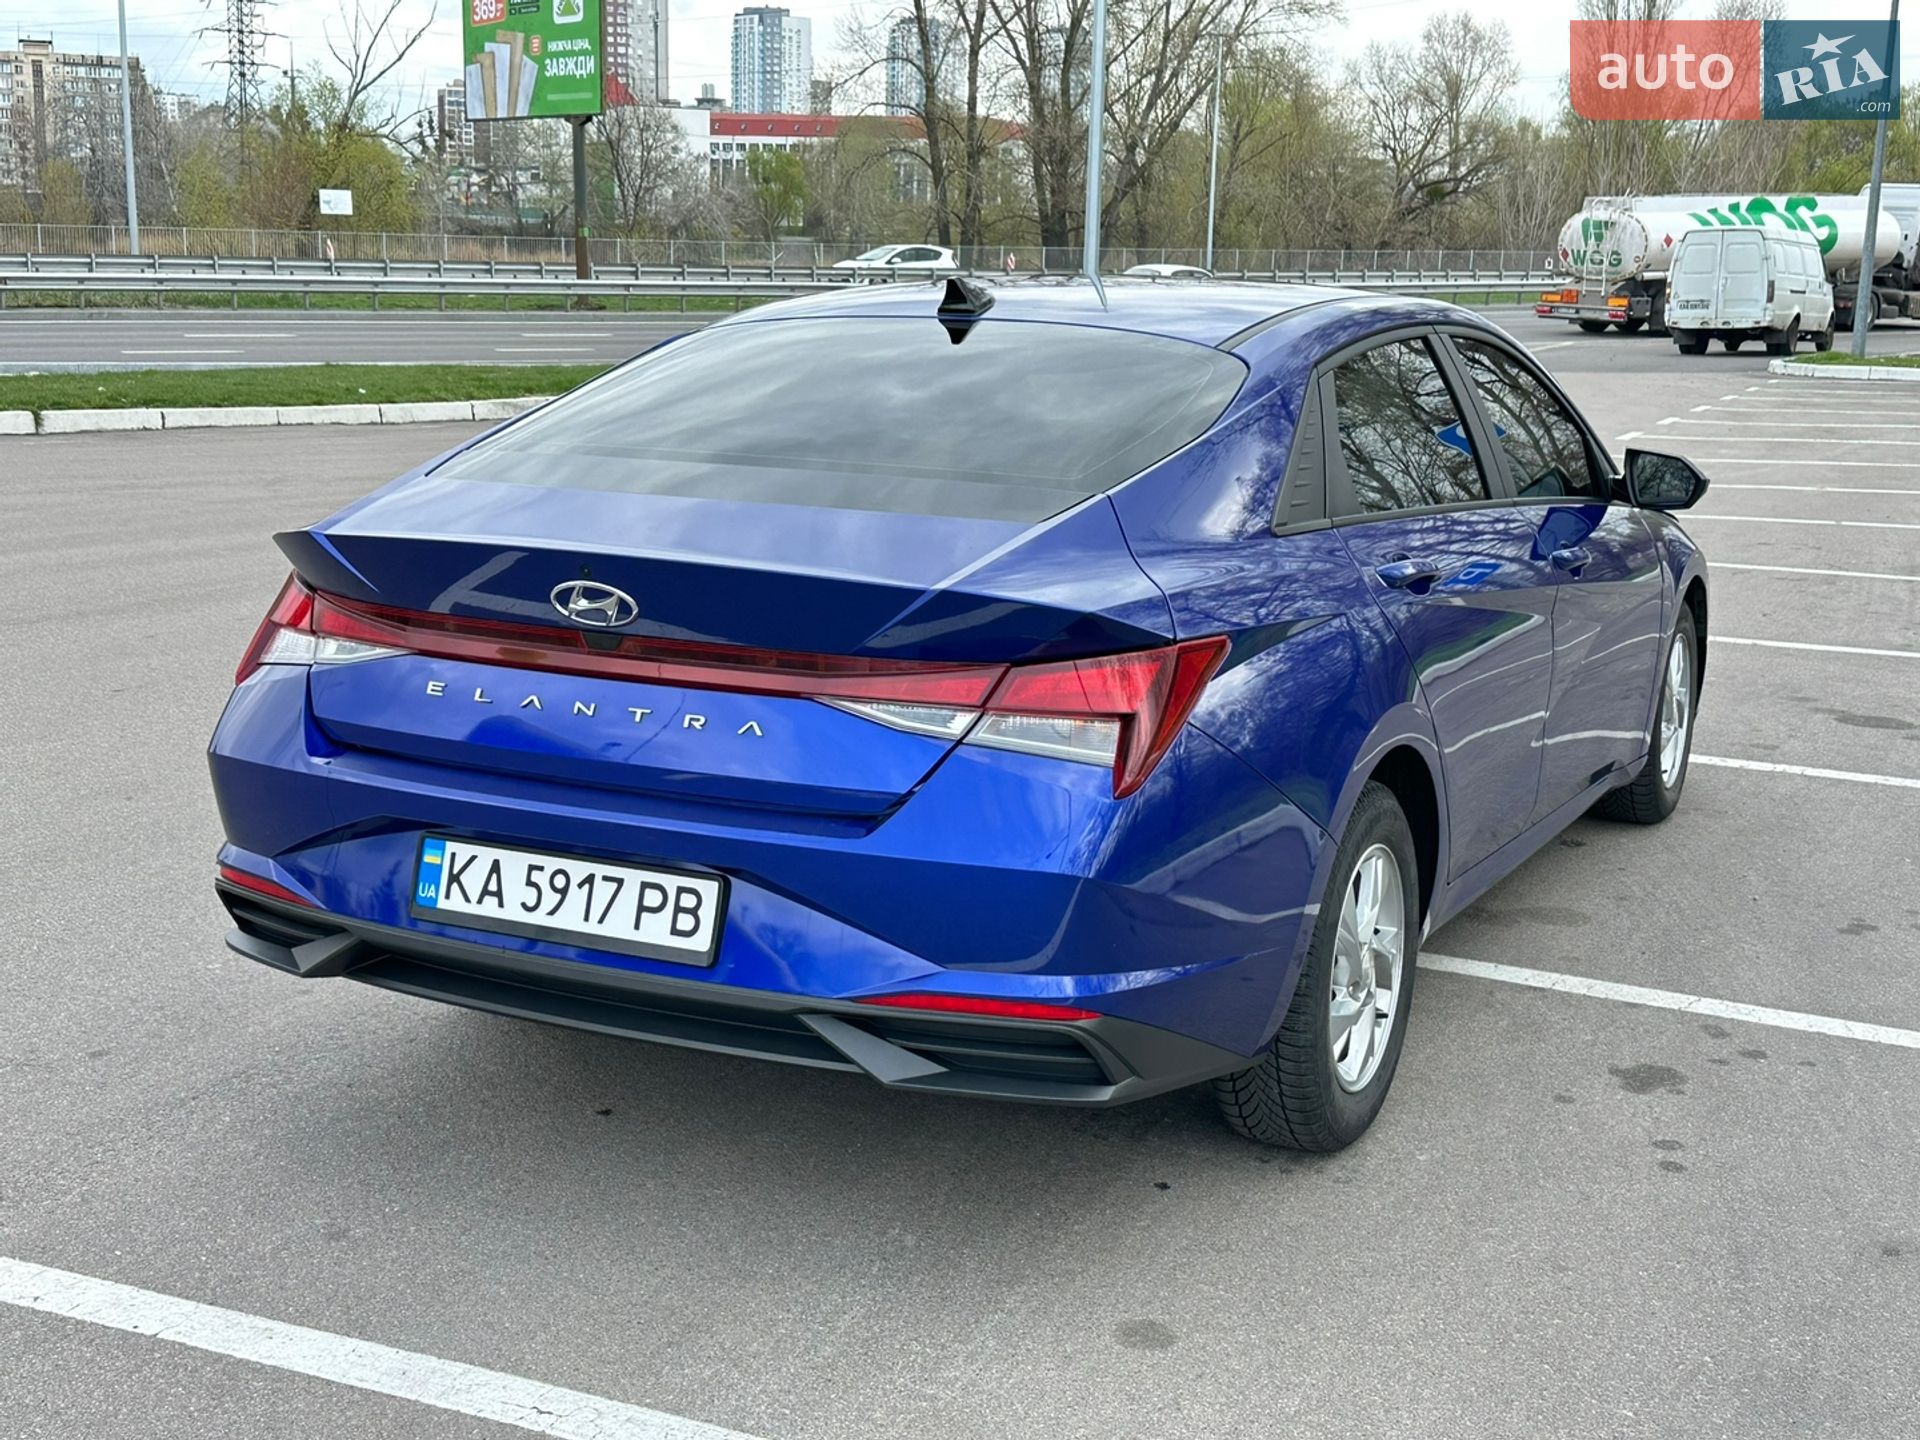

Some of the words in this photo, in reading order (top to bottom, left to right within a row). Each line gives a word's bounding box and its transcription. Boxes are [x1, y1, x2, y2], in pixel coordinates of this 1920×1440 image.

[544, 55, 595, 79] ЗАВЖДИ
[425, 680, 765, 737] ELANTRA
[418, 882, 436, 899] UA
[444, 852, 505, 909] KA
[520, 863, 625, 925] 5917
[633, 880, 703, 938] PB
